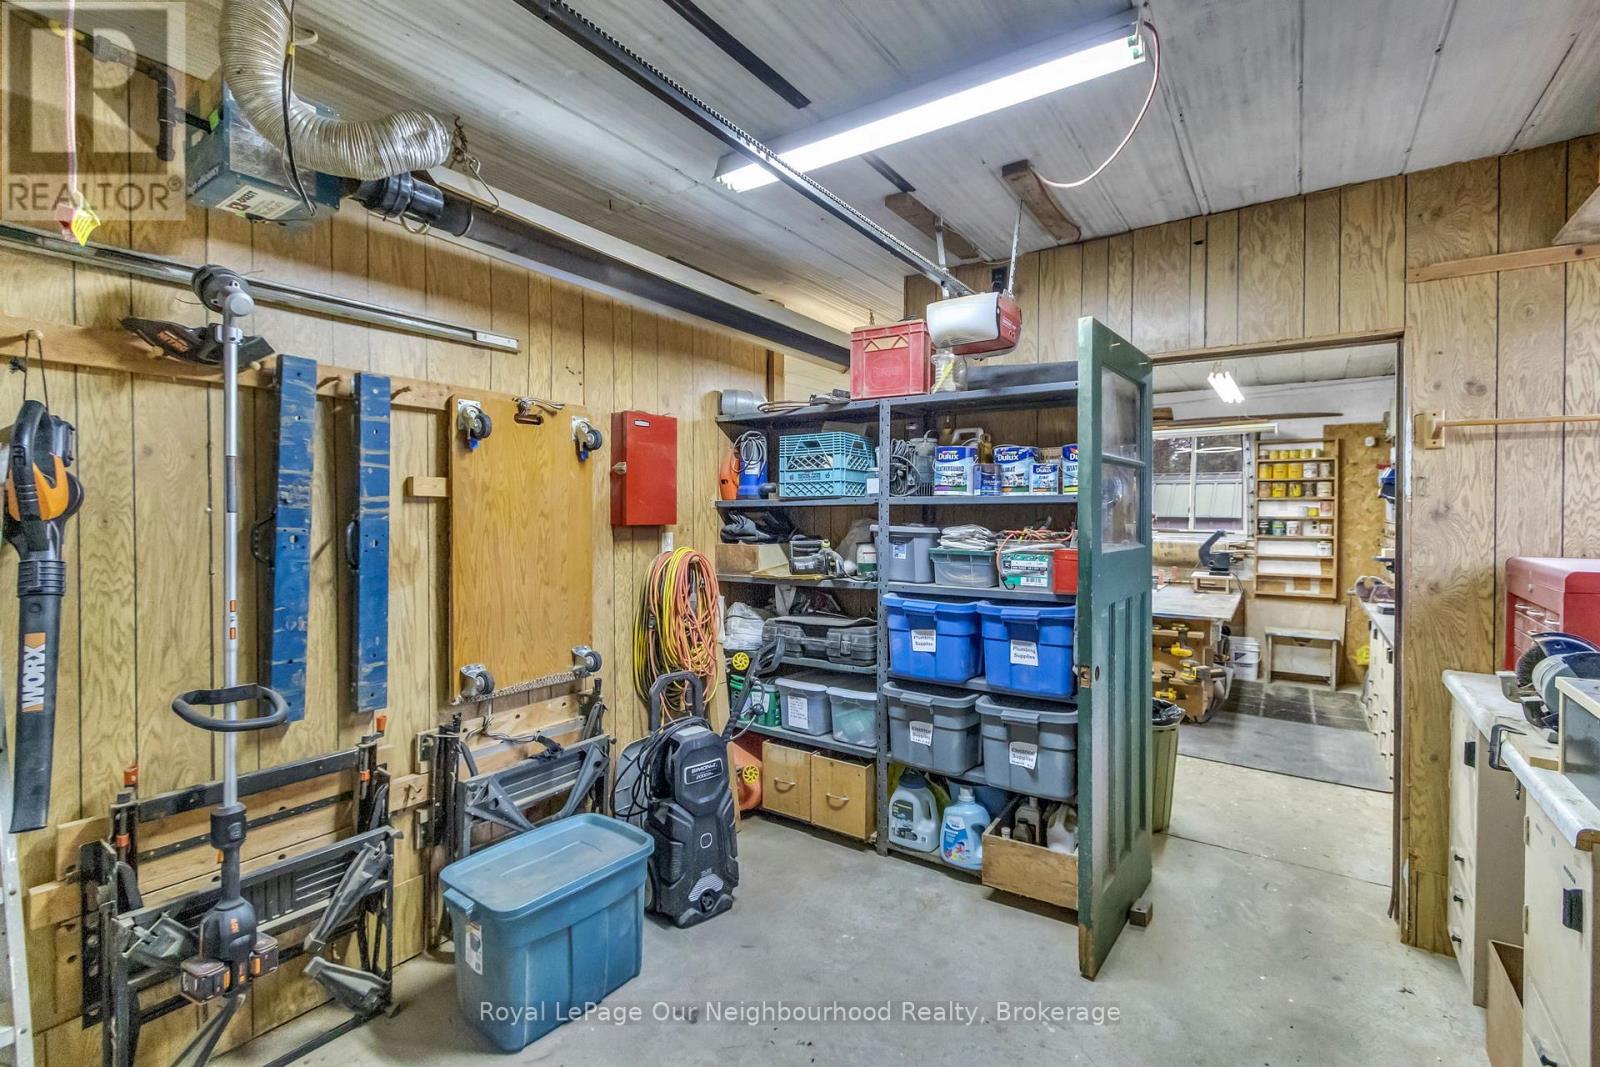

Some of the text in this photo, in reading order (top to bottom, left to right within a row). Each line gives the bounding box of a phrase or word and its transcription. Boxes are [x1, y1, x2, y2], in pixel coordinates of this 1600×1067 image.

[938, 452, 960, 460] Dulux
[997, 453, 1019, 461] Dulux
[1012, 645, 1036, 655] Plumbing
[1013, 652, 1035, 660] Supplies
[22, 643, 46, 708] WORX
